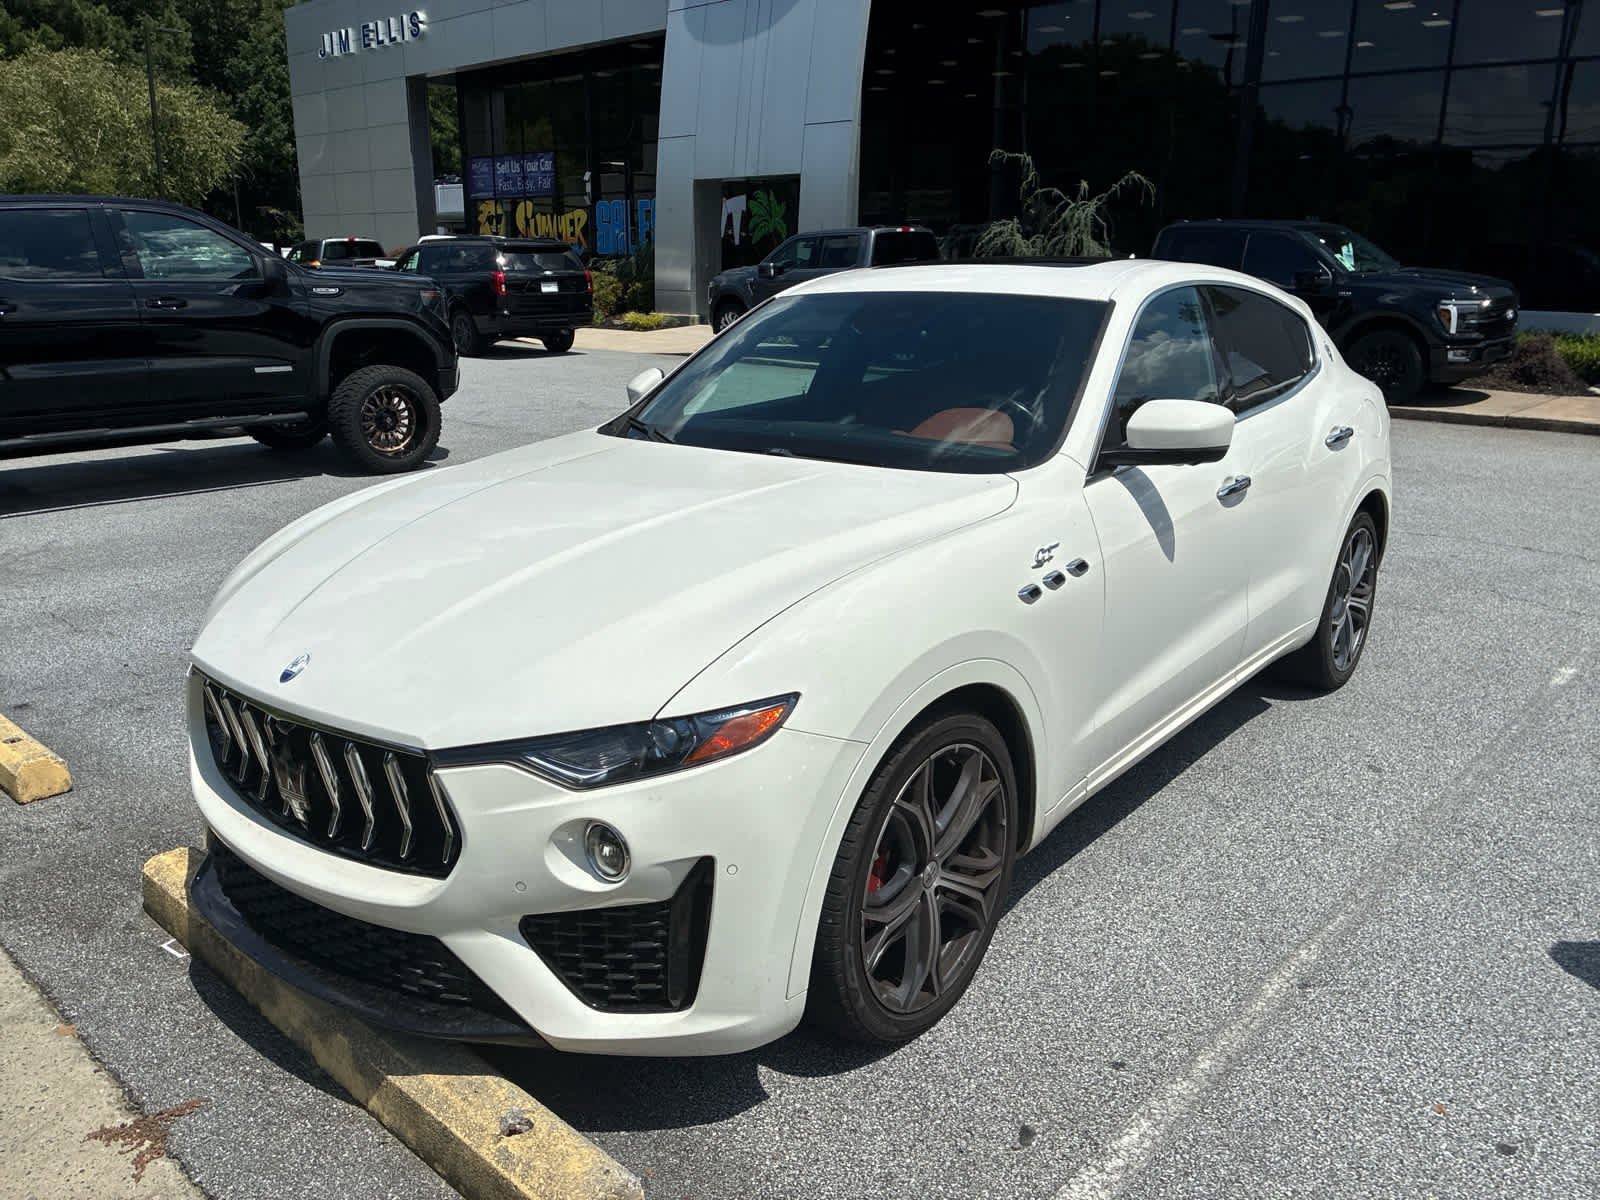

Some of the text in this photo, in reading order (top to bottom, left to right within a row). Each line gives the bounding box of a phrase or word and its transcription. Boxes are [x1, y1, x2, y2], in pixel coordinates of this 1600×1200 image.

[319, 11, 426, 58] JIM ELLIS
[496, 160, 510, 174] Sell
[511, 160, 520, 173] Us
[540, 158, 552, 171] Car
